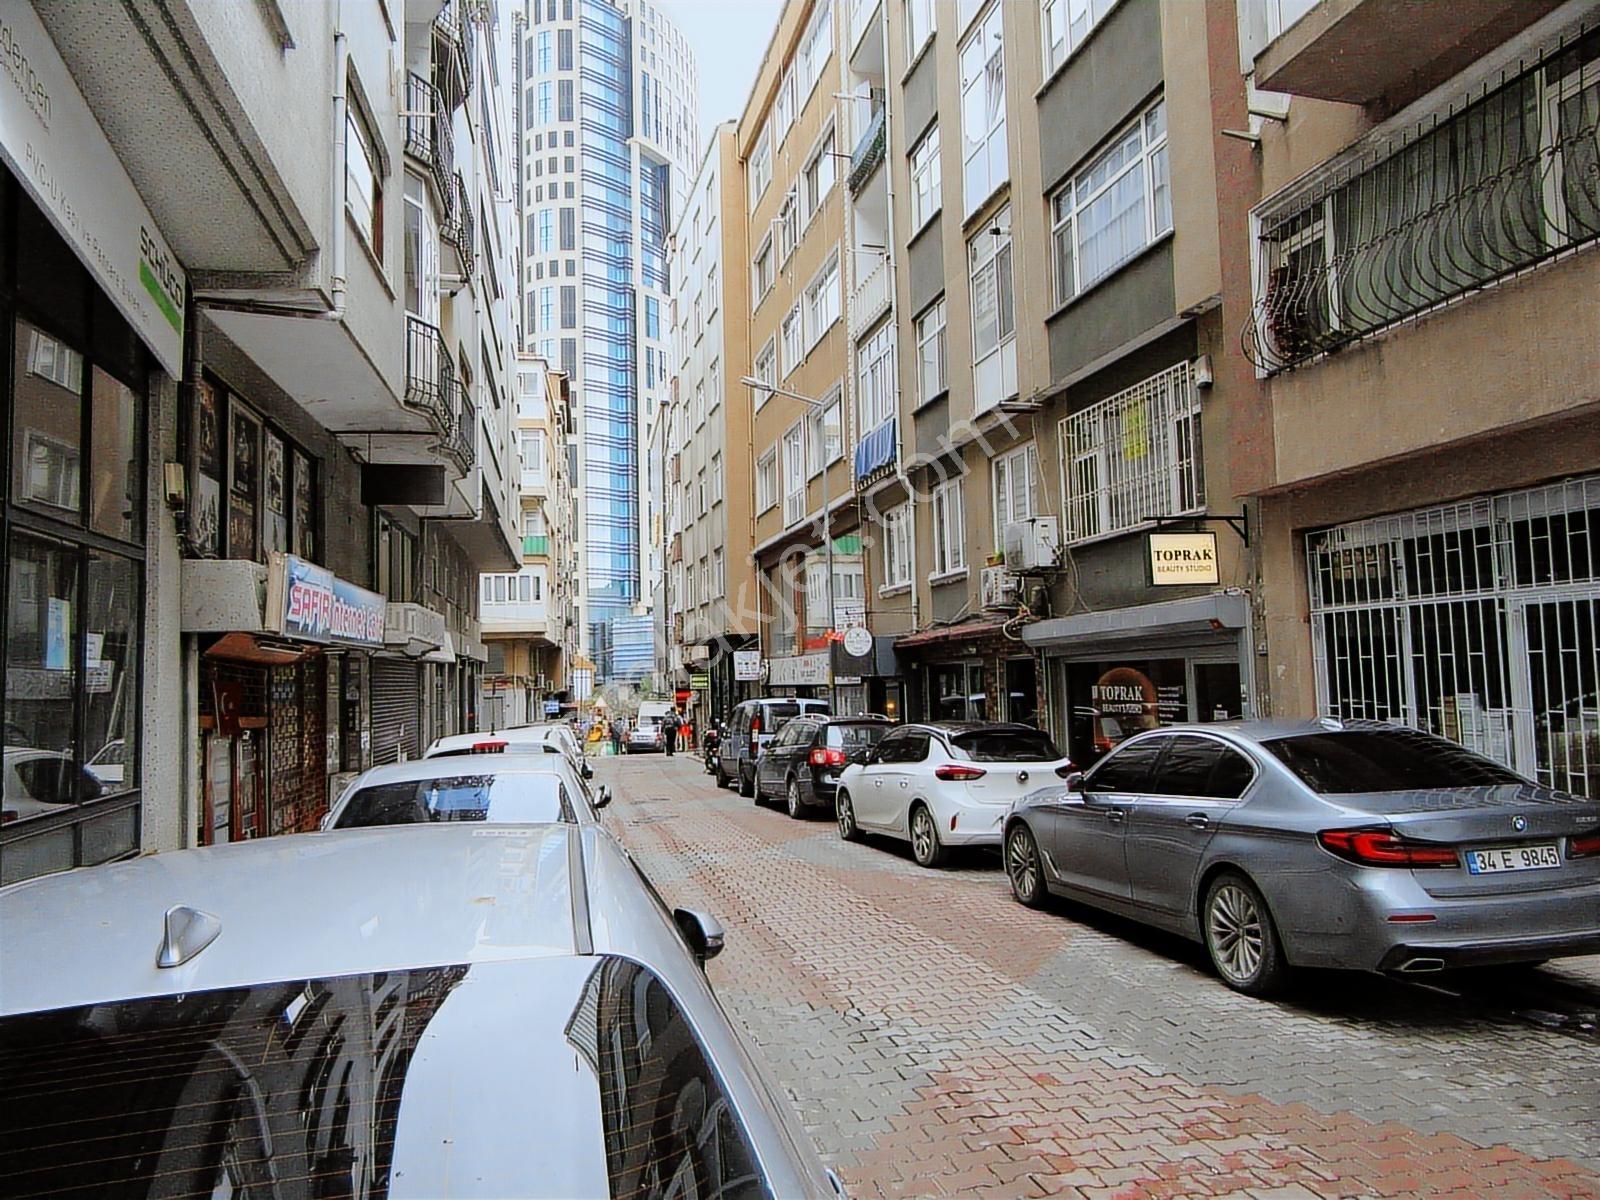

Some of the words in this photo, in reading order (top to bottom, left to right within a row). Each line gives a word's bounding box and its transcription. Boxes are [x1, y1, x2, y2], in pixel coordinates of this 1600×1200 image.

[1153, 548, 1214, 562] TOPRAK
[1157, 564, 1183, 573] BEAUTY
[1100, 685, 1144, 701] TOPRAK
[1476, 852, 1497, 871] 34
[1501, 851, 1515, 869] E
[1521, 847, 1558, 867] 9845
